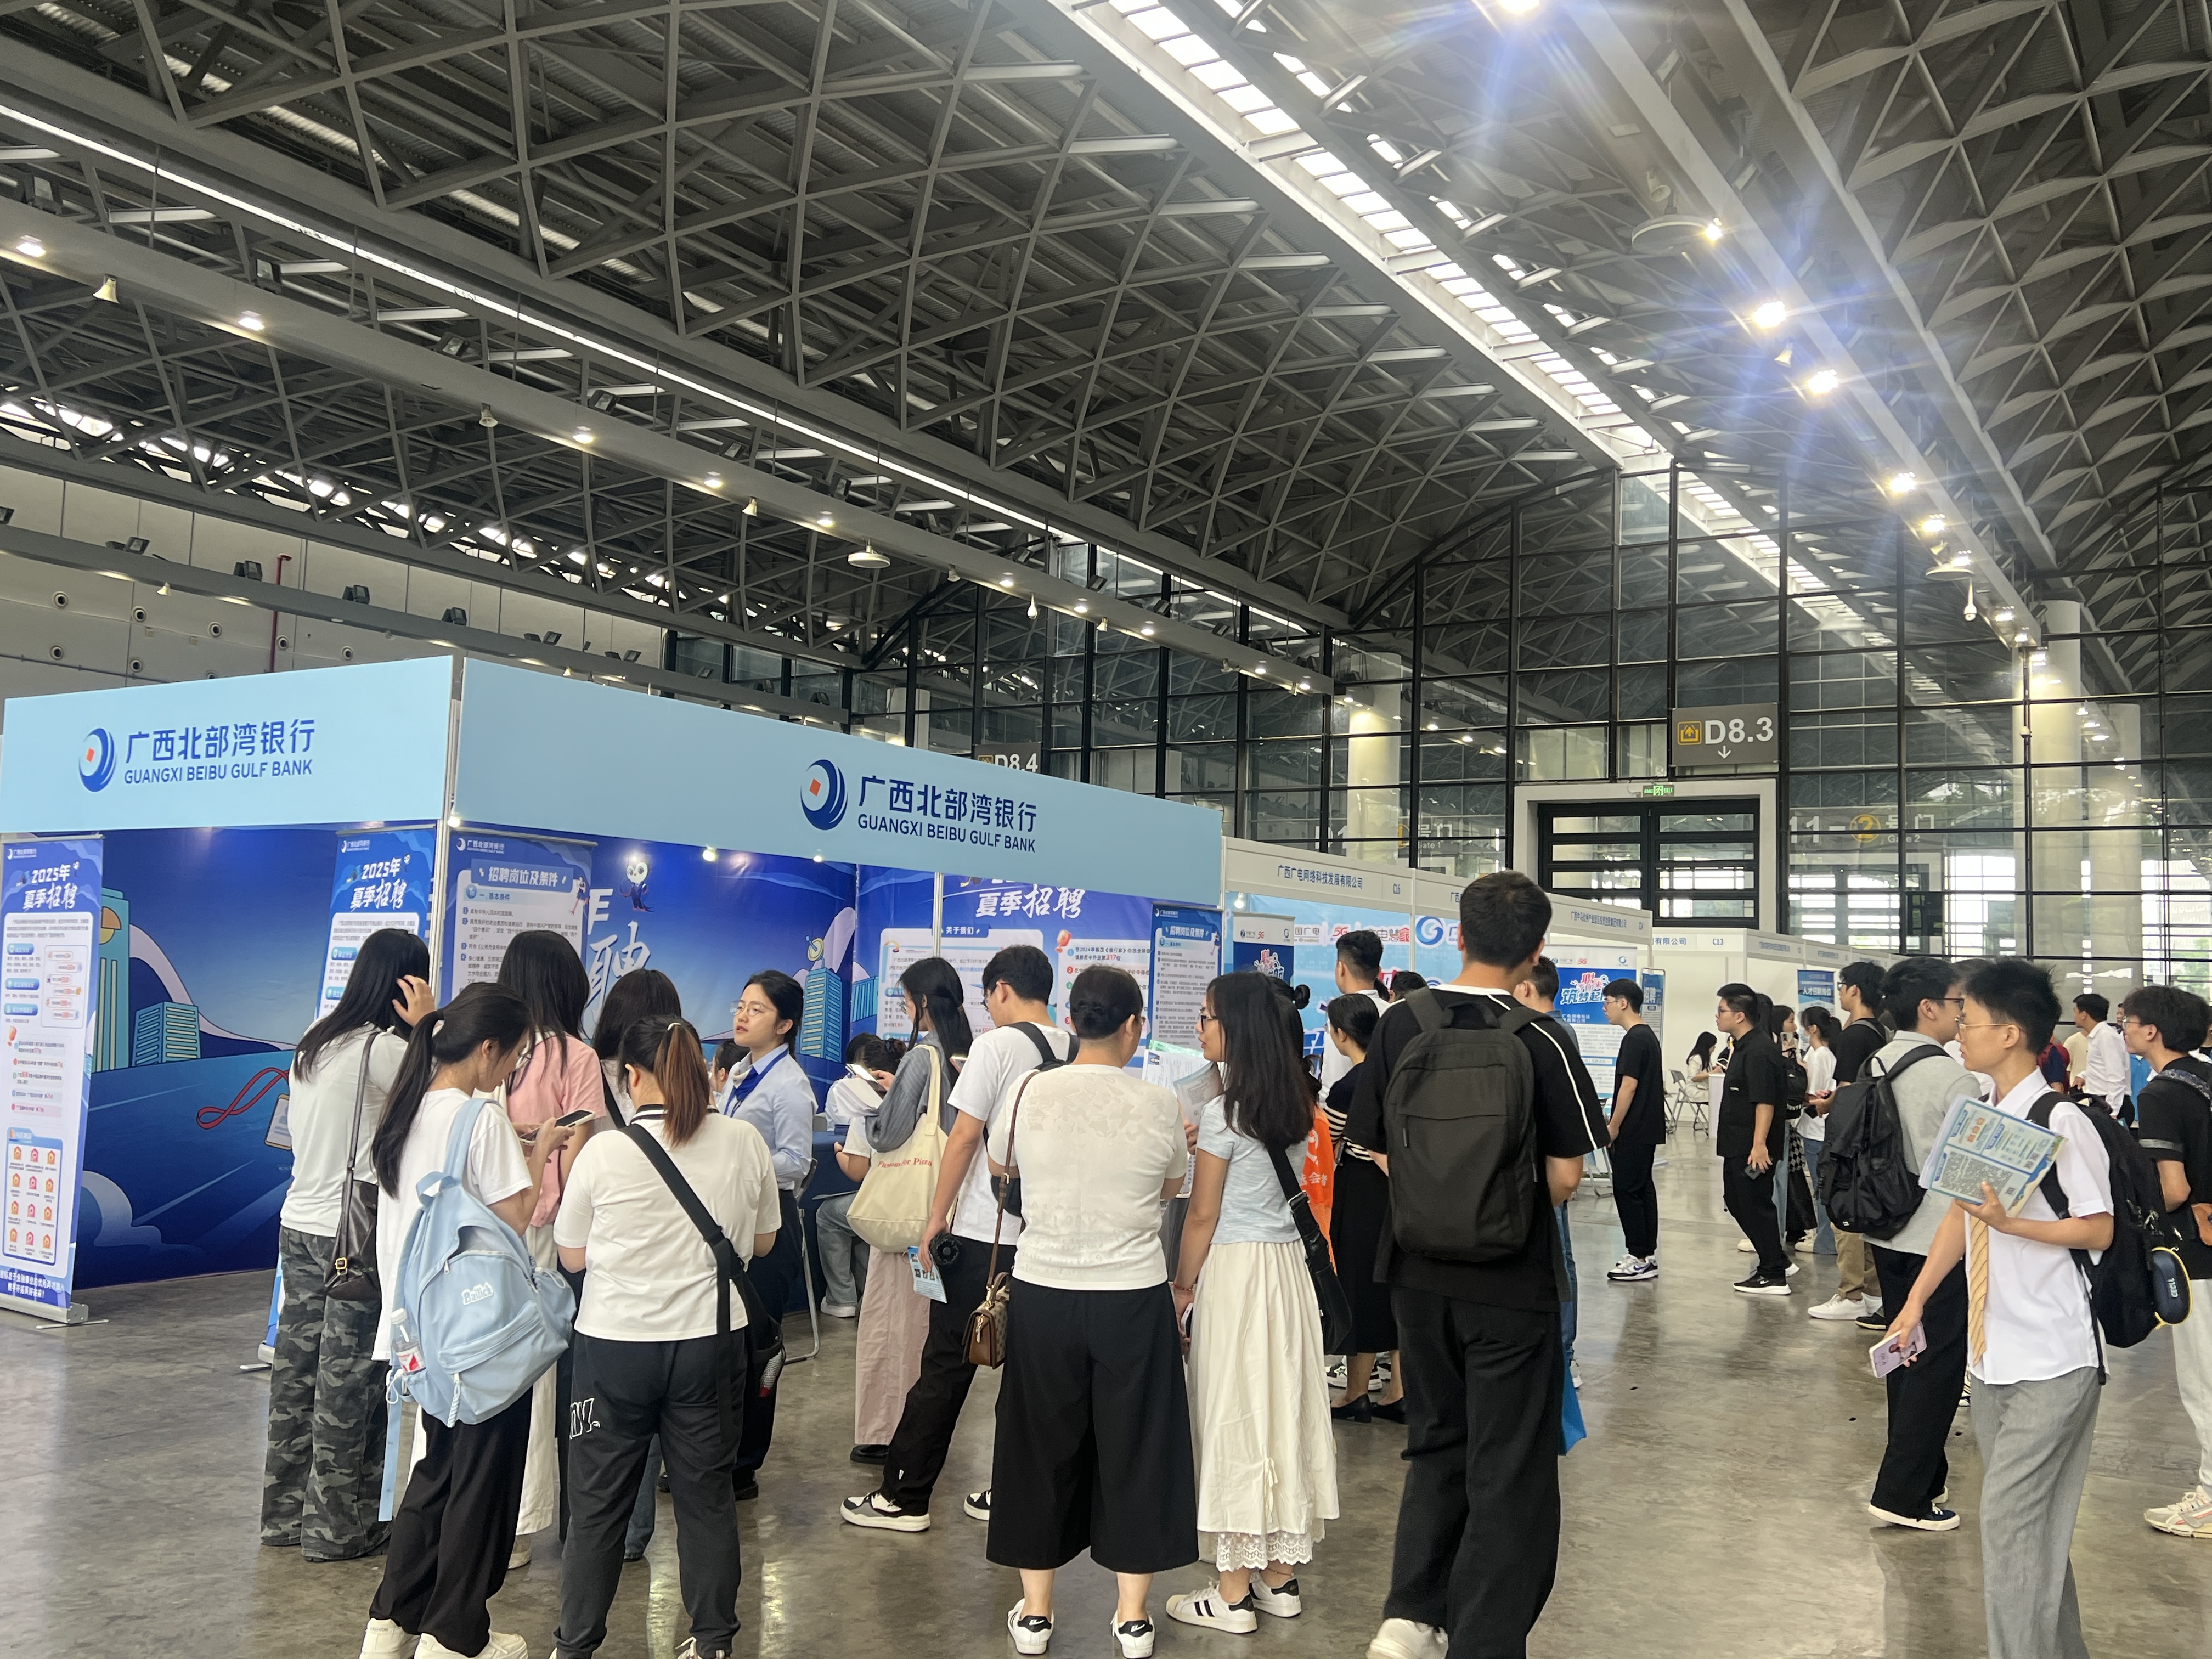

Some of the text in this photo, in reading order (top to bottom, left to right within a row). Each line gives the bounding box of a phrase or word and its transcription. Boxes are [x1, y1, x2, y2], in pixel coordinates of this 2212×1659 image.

[125, 719, 315, 764] 广西北部湾银行
[1705, 717, 1773, 744] D8.3
[124, 759, 313, 785] GUANGXI BEIBU GULF BANK
[859, 775, 1037, 833] 广西北部湾银行
[858, 814, 1036, 853] GUANGXI BEIBU GULF BANK
[31, 864, 71, 884] 2025年
[361, 857, 402, 879] 2025年
[488, 866, 558, 887] 招聘岗位及条件
[1277, 865, 1363, 889] 广西广电网络科技发展有限公司
[22, 882, 78, 910] 夏季招聘
[350, 878, 407, 910] 夏季招聘
[975, 884, 1086, 919] 夏季招聘
[946, 926, 974, 935] 关于我们
